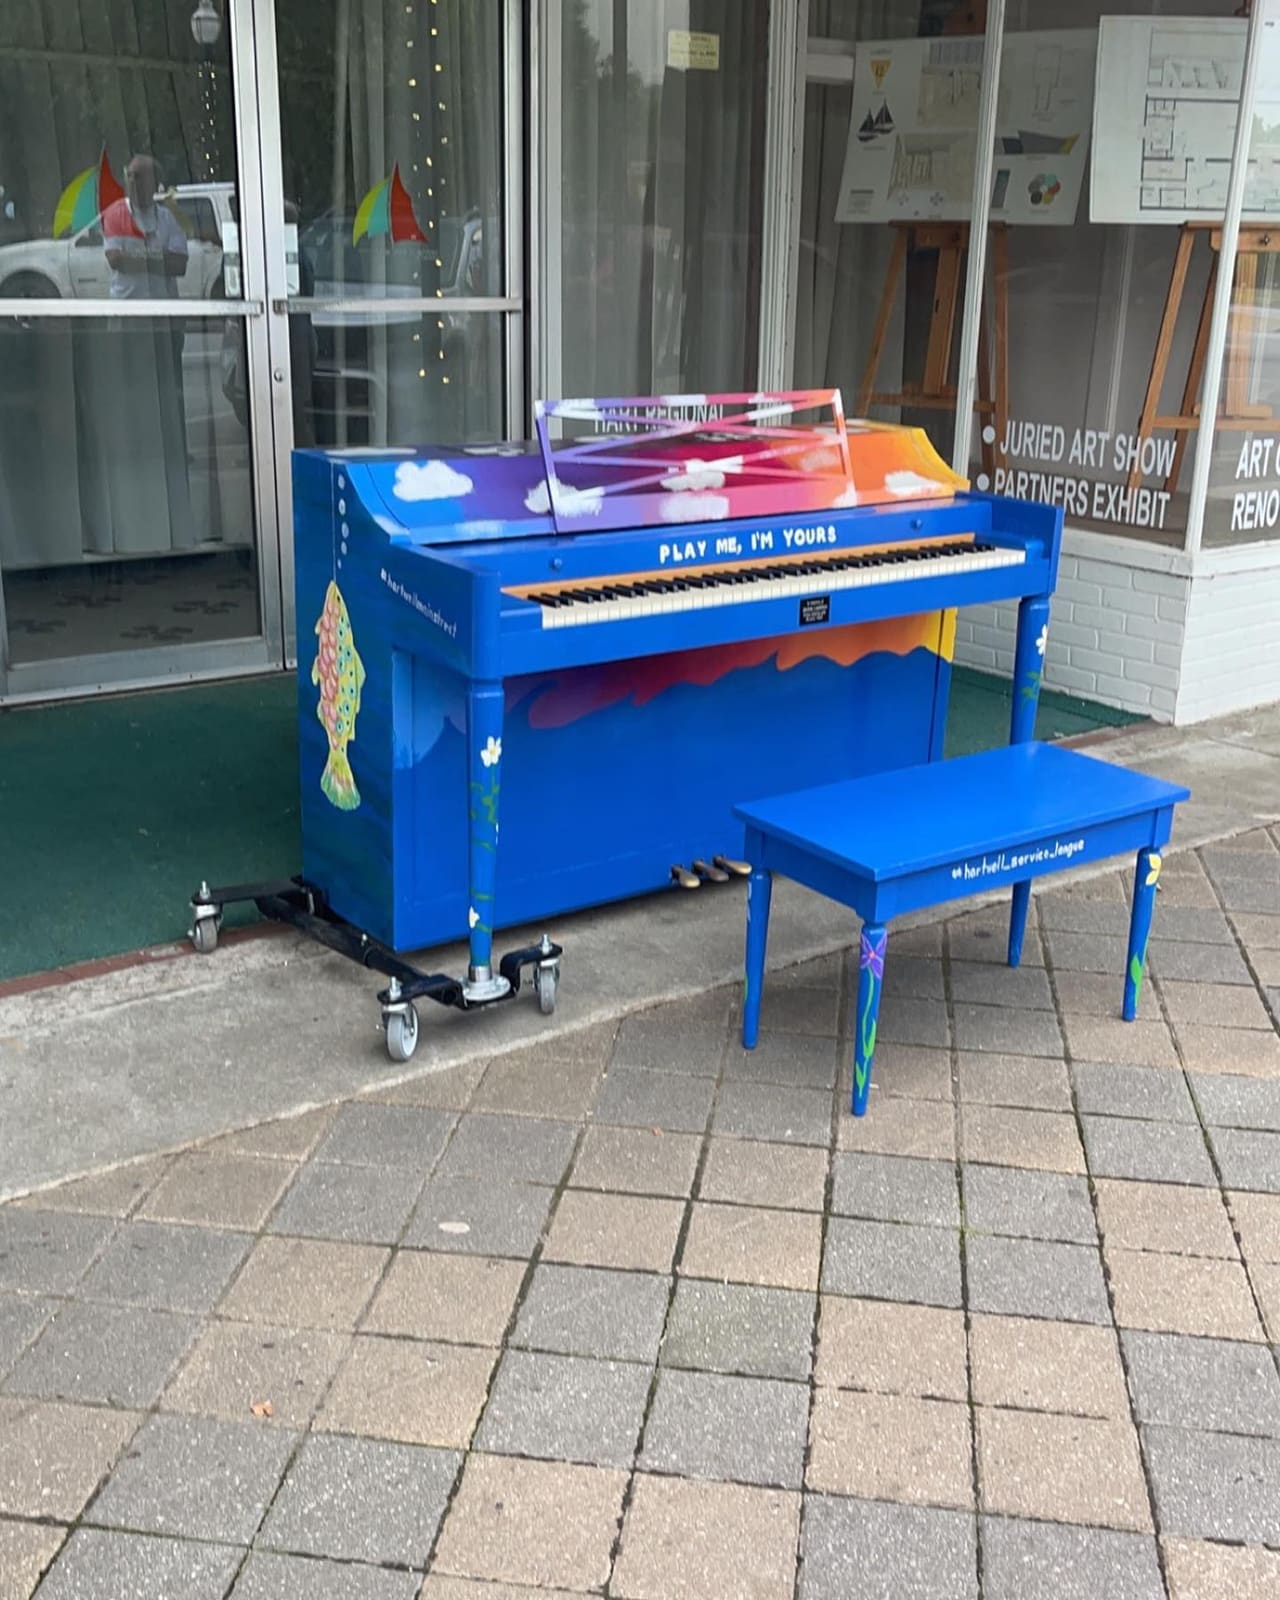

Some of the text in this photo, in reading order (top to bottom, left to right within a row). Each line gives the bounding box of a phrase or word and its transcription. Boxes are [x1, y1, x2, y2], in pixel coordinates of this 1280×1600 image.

[1000, 420, 1177, 478] JURIED ART SHOW
[1235, 438, 1274, 479] ART
[994, 467, 1170, 530] PARTNERS EXHIBIT
[1231, 489, 1279, 531] RENO
[659, 525, 837, 564] PLAY ME, I'M YOURS
